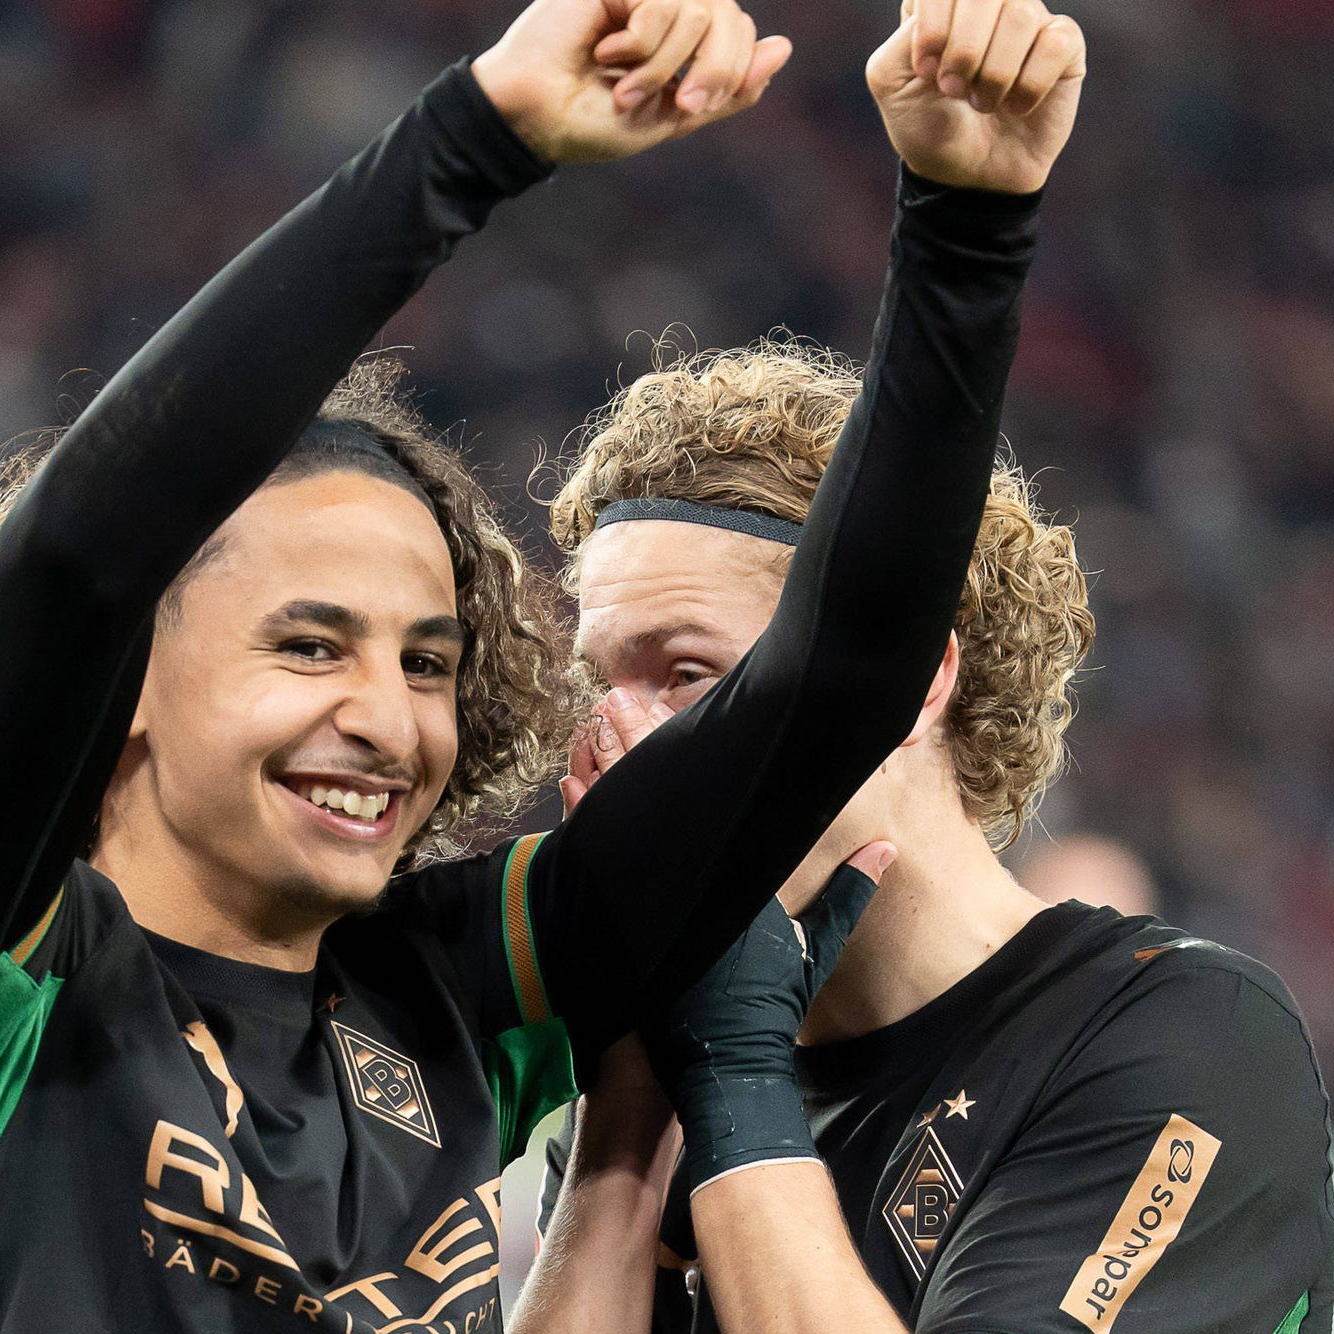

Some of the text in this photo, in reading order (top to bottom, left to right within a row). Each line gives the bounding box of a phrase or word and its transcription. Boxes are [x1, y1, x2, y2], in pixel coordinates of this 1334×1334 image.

[362, 1059, 412, 1110] B
[145, 1119, 501, 1320] RETE
[915, 1183, 949, 1238] B
[1085, 1184, 1174, 1320] sonpar
